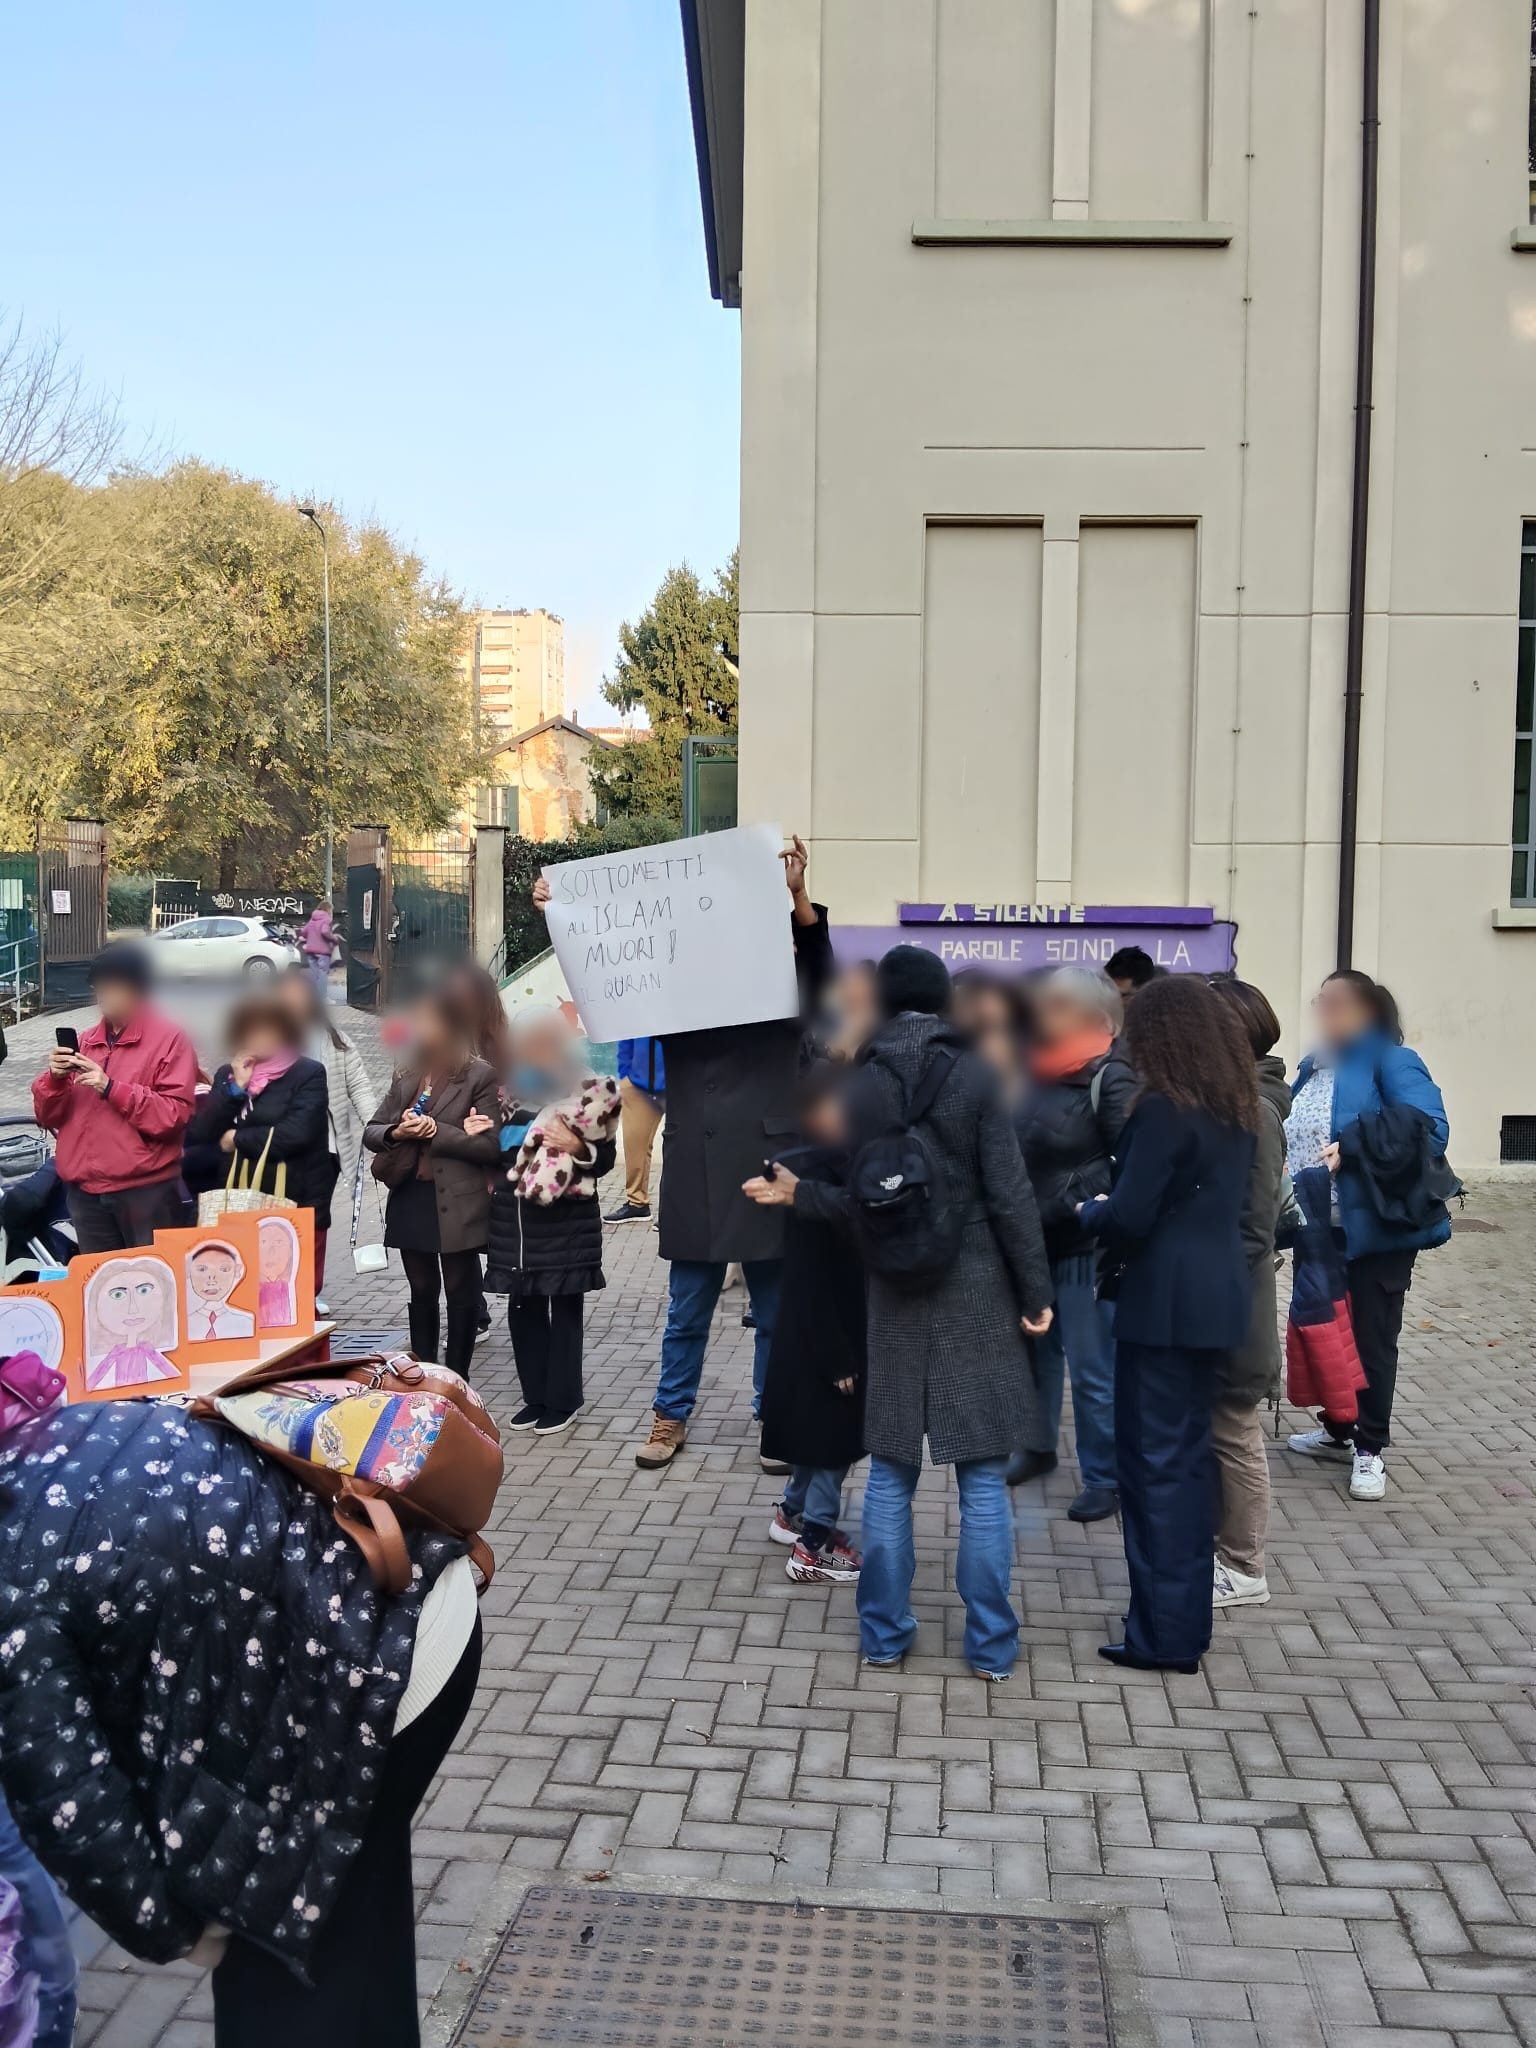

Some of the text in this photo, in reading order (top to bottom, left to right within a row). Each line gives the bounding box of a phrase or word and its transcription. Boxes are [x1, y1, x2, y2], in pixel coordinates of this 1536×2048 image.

[560, 853, 705, 905] SOTTOMETTI
[567, 895, 713, 938] ALL ISLAM O
[973, 903, 1086, 924] SILENTE
[584, 935, 656, 974] MUORI
[940, 939, 1024, 961] PAROLE
[1045, 938, 1116, 962] SONO
[1156, 939, 1191, 967] LA
[603, 971, 662, 1004] QURAN
